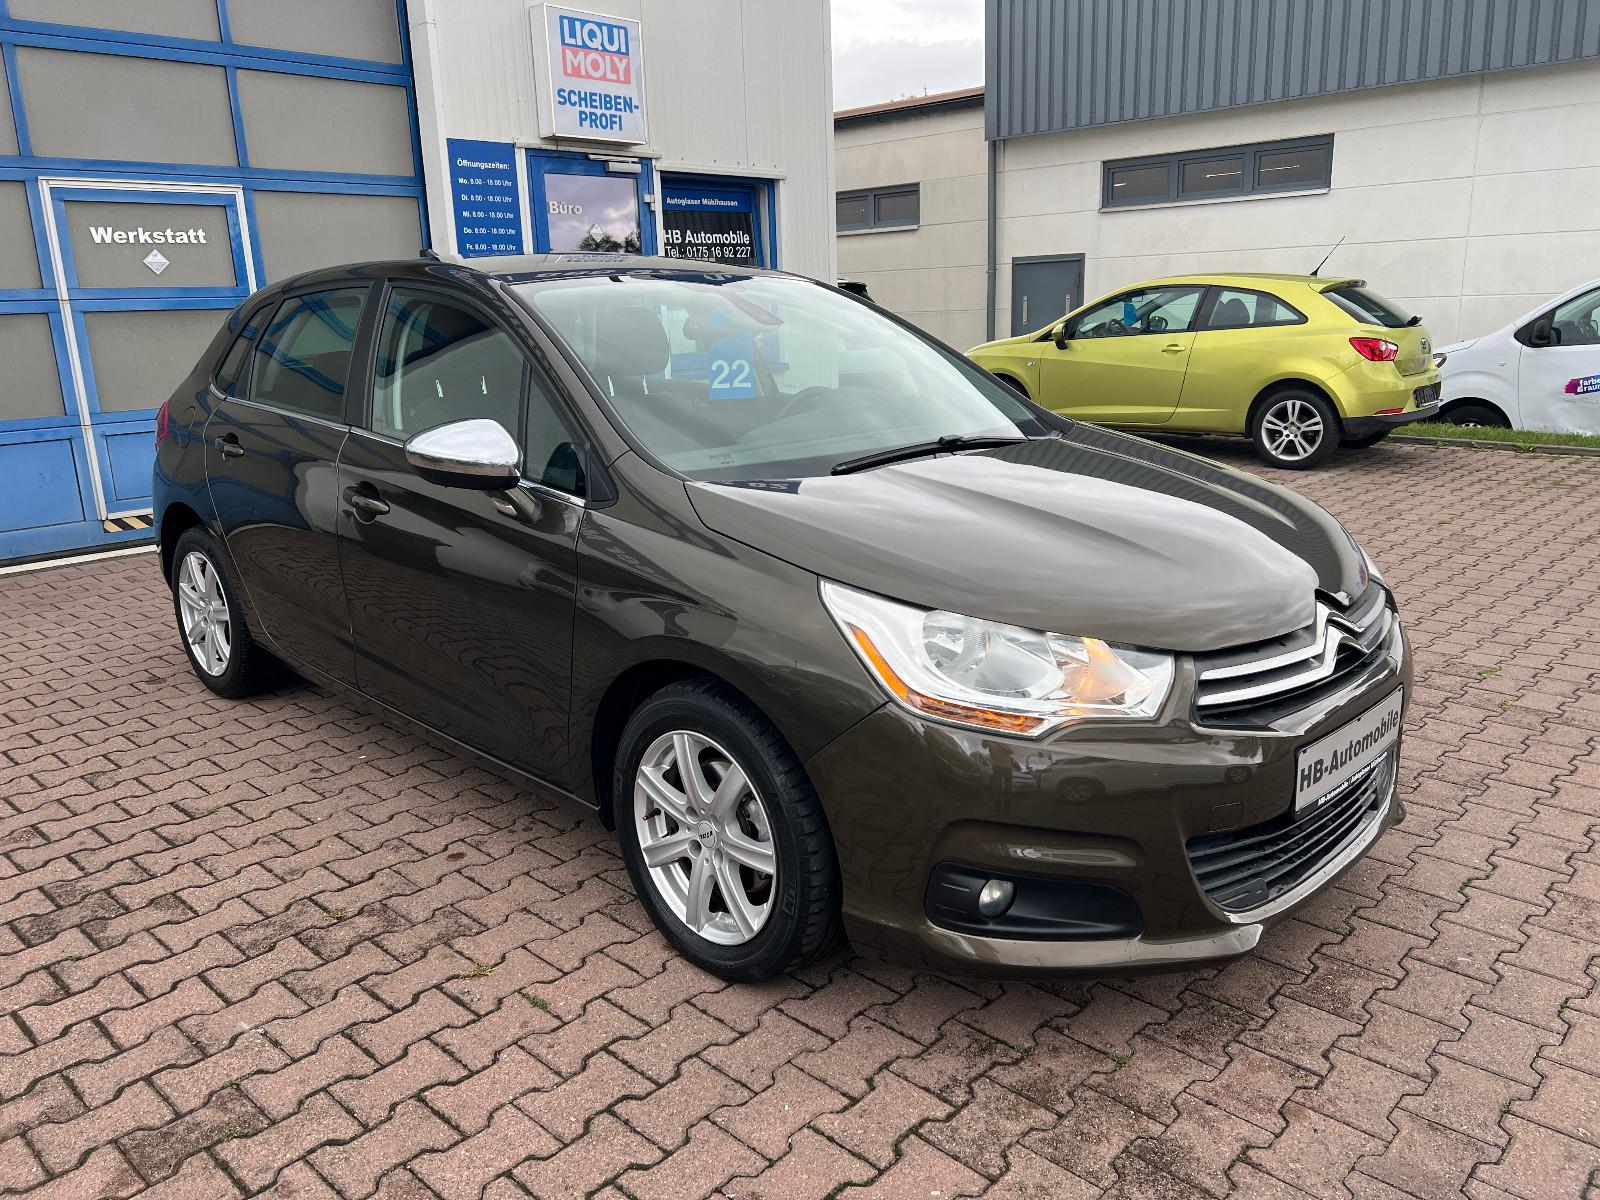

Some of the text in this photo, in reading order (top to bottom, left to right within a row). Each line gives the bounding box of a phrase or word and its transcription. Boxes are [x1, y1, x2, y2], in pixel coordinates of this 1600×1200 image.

[562, 18, 627, 53] LIQUI
[565, 48, 628, 81] MOLY
[557, 88, 640, 113] SCHEIBEN-
[578, 110, 623, 131] PROFI
[457, 158, 510, 170] Öffnungszeiten:
[549, 200, 583, 215] Büro
[666, 197, 738, 206] Autoglaser Mühlhausen
[88, 226, 207, 244] Werkstatt
[663, 229, 750, 244] HB Automobile
[665, 246, 751, 258] Tel.: 0175 16 92 227
[711, 359, 752, 389] 22
[1299, 709, 1399, 792] HB-Automobile
